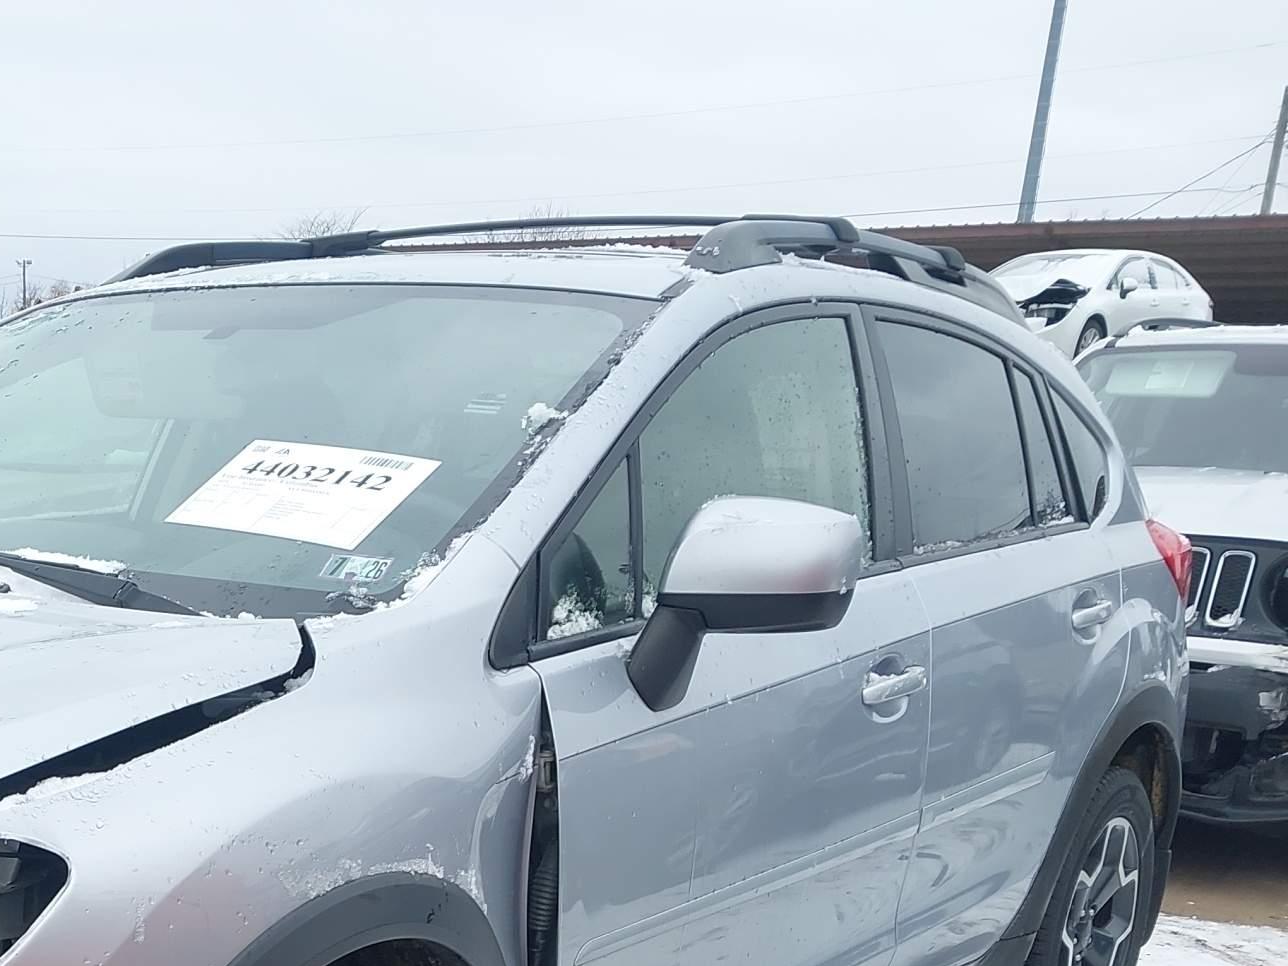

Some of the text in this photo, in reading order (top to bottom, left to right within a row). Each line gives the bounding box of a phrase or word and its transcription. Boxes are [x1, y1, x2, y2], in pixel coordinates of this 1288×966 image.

[242, 460, 393, 491] 44032142
[328, 557, 388, 580] 7 26
